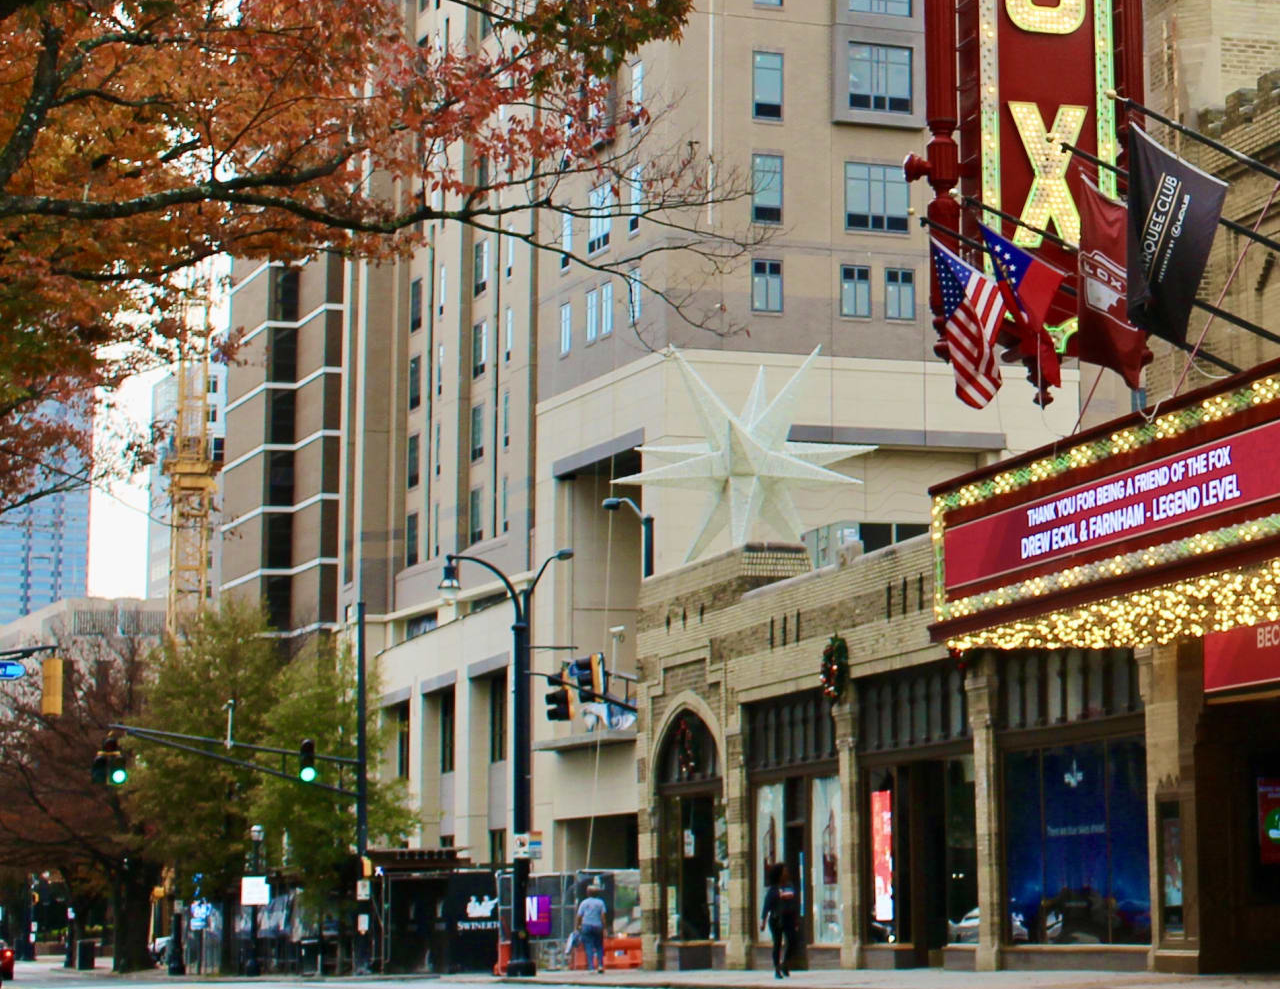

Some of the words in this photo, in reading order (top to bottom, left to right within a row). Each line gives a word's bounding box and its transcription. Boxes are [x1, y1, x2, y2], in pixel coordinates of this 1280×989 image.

[1143, 212, 1166, 271] ARQUEE
[1157, 175, 1178, 212] CLUB
[1083, 261, 1122, 292] FOX
[1021, 529, 1052, 559] DREW
[1052, 522, 1079, 550] ECKL
[1079, 519, 1089, 542] &
[1089, 502, 1145, 539] FARNHAM
[1152, 486, 1201, 521] LEGEND
[1201, 474, 1241, 506] LEVEL
[1027, 500, 1057, 527] THANK
[1056, 496, 1077, 518] YOU
[1076, 491, 1096, 512] FOR
[1096, 481, 1125, 506] BEING
[1126, 478, 1136, 497] A
[1134, 467, 1170, 494] FRIEND
[1171, 463, 1186, 482] OF
[1186, 454, 1208, 478] THE
[1208, 445, 1232, 471] FOX
[457, 921, 500, 931] SWINERT
